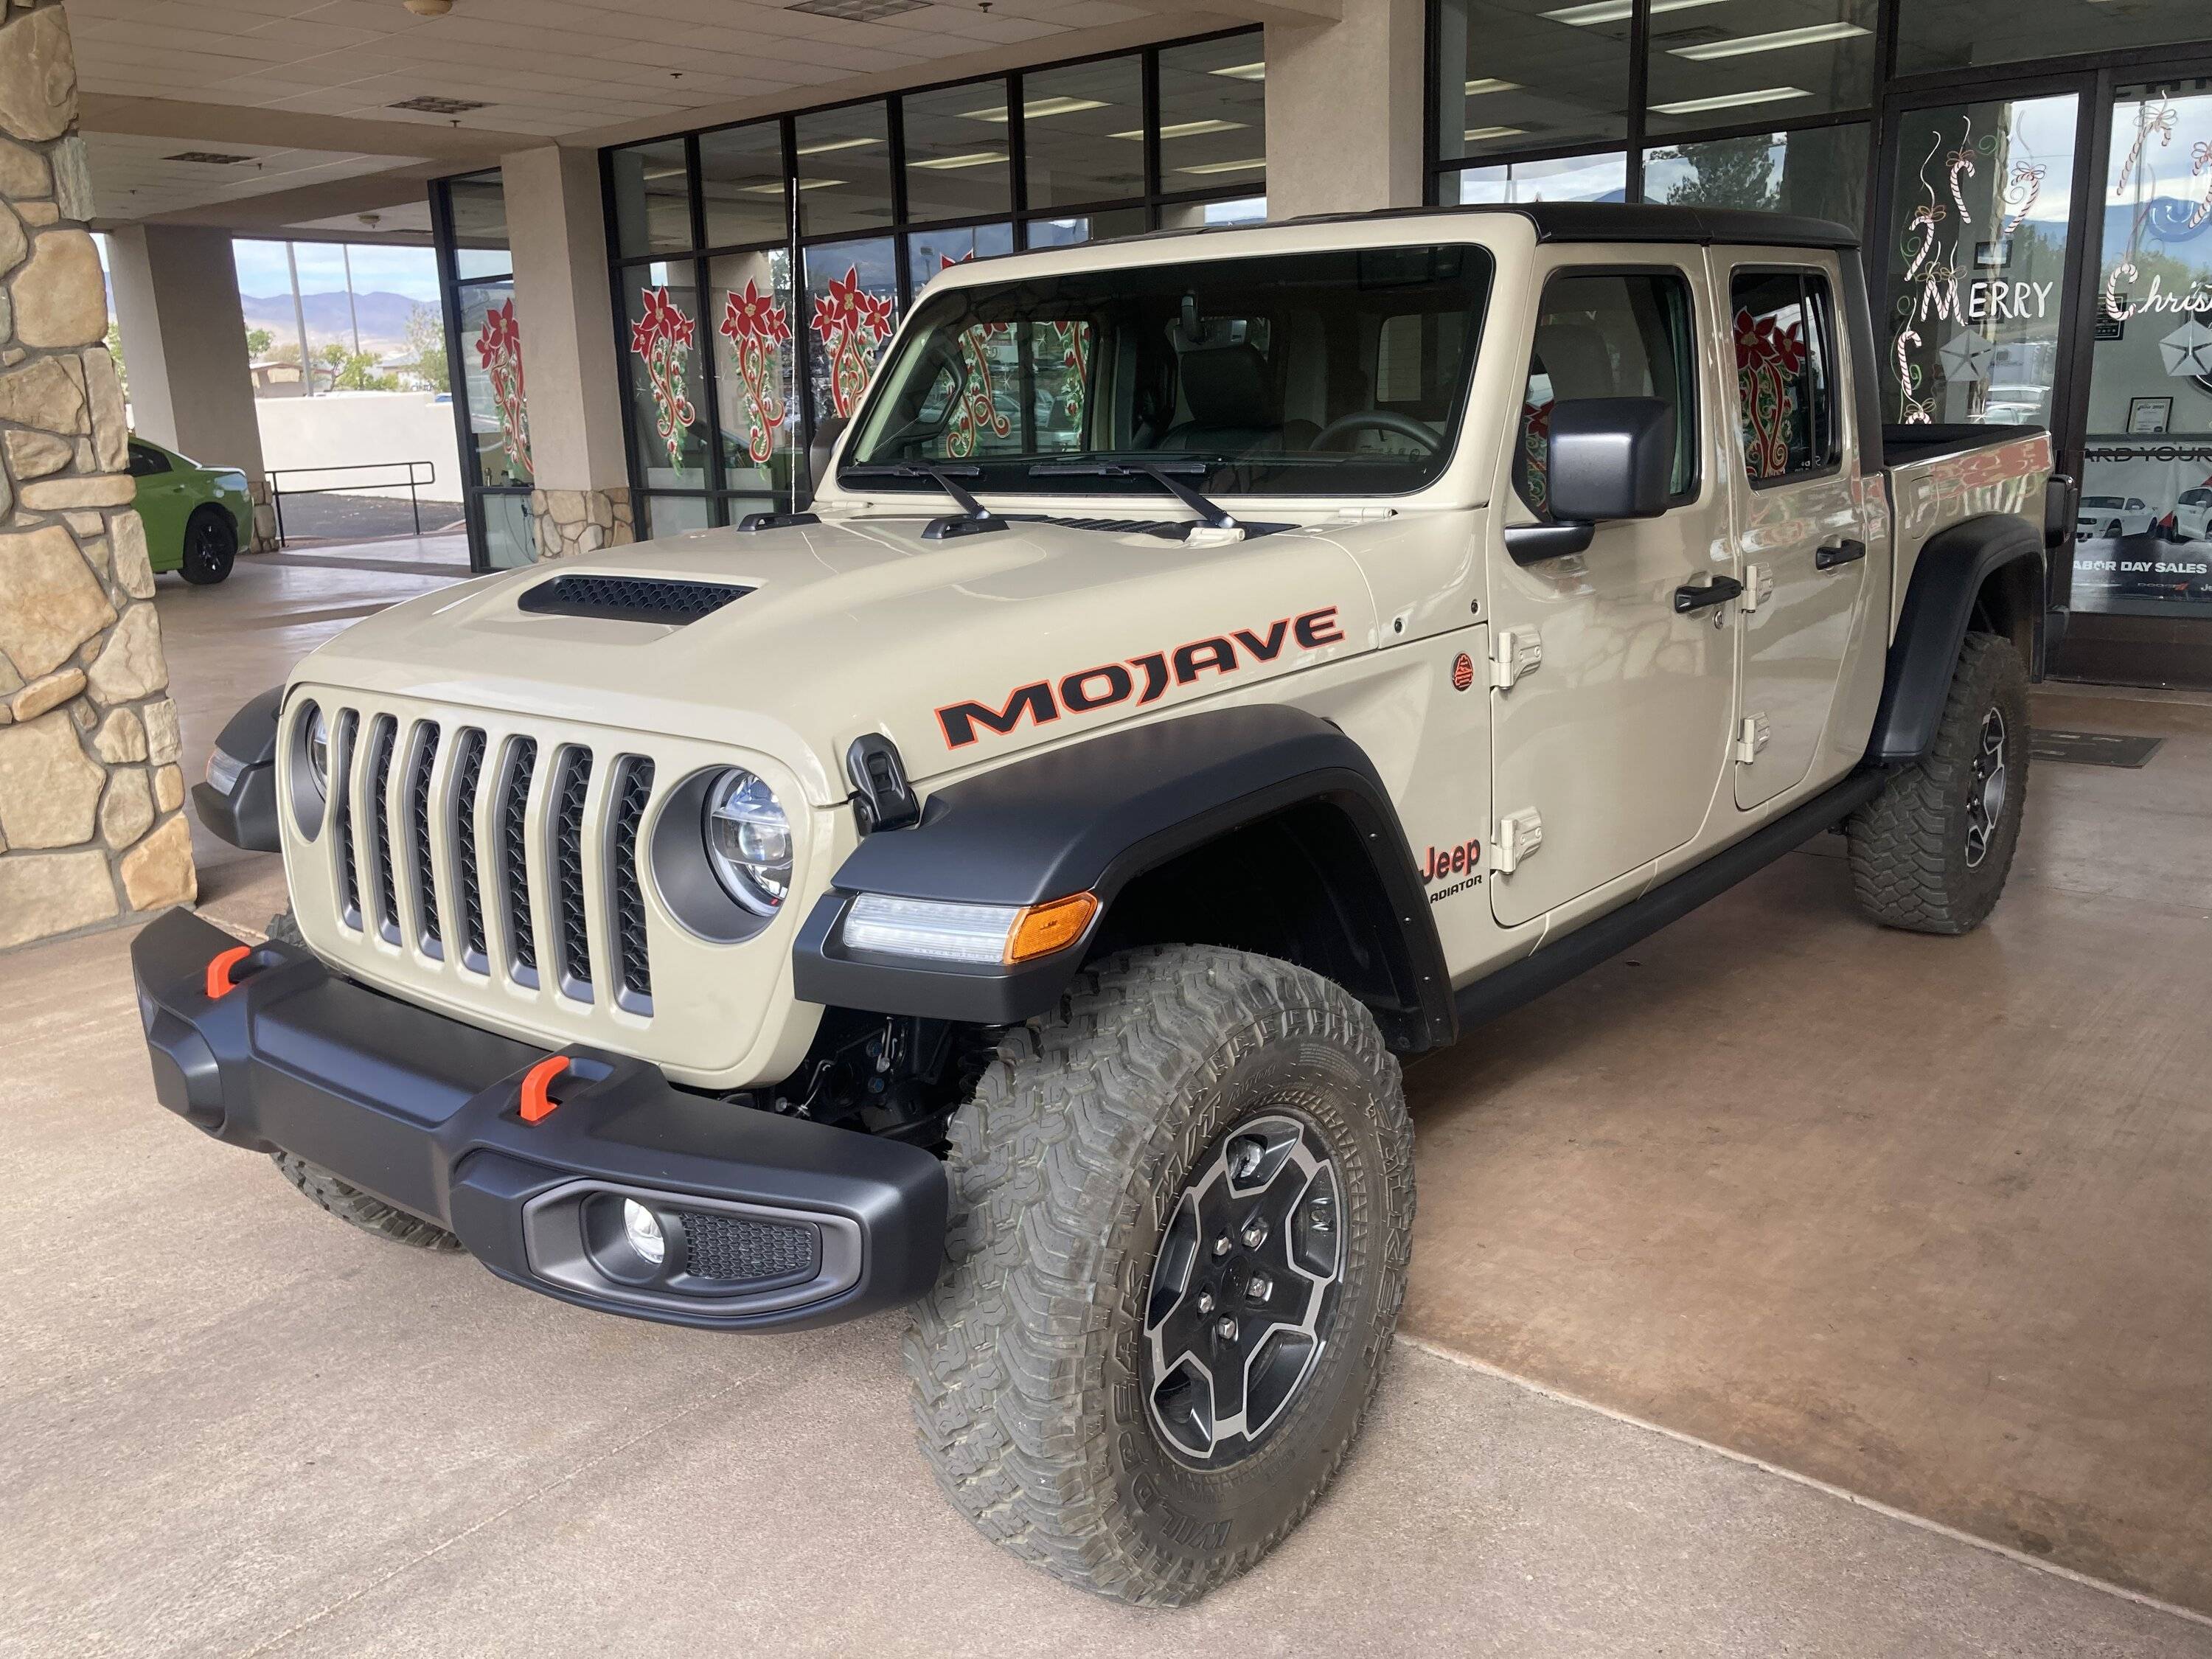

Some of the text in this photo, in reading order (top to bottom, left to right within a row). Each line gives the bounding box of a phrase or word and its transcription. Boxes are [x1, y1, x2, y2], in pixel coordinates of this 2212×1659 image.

[1921, 276, 2053, 327] MERRY
[2121, 561, 2153, 572] DAY
[2154, 562, 2208, 574] SALES
[934, 606, 1345, 751] MOJAVE
[1417, 838, 1481, 886] Jeep
